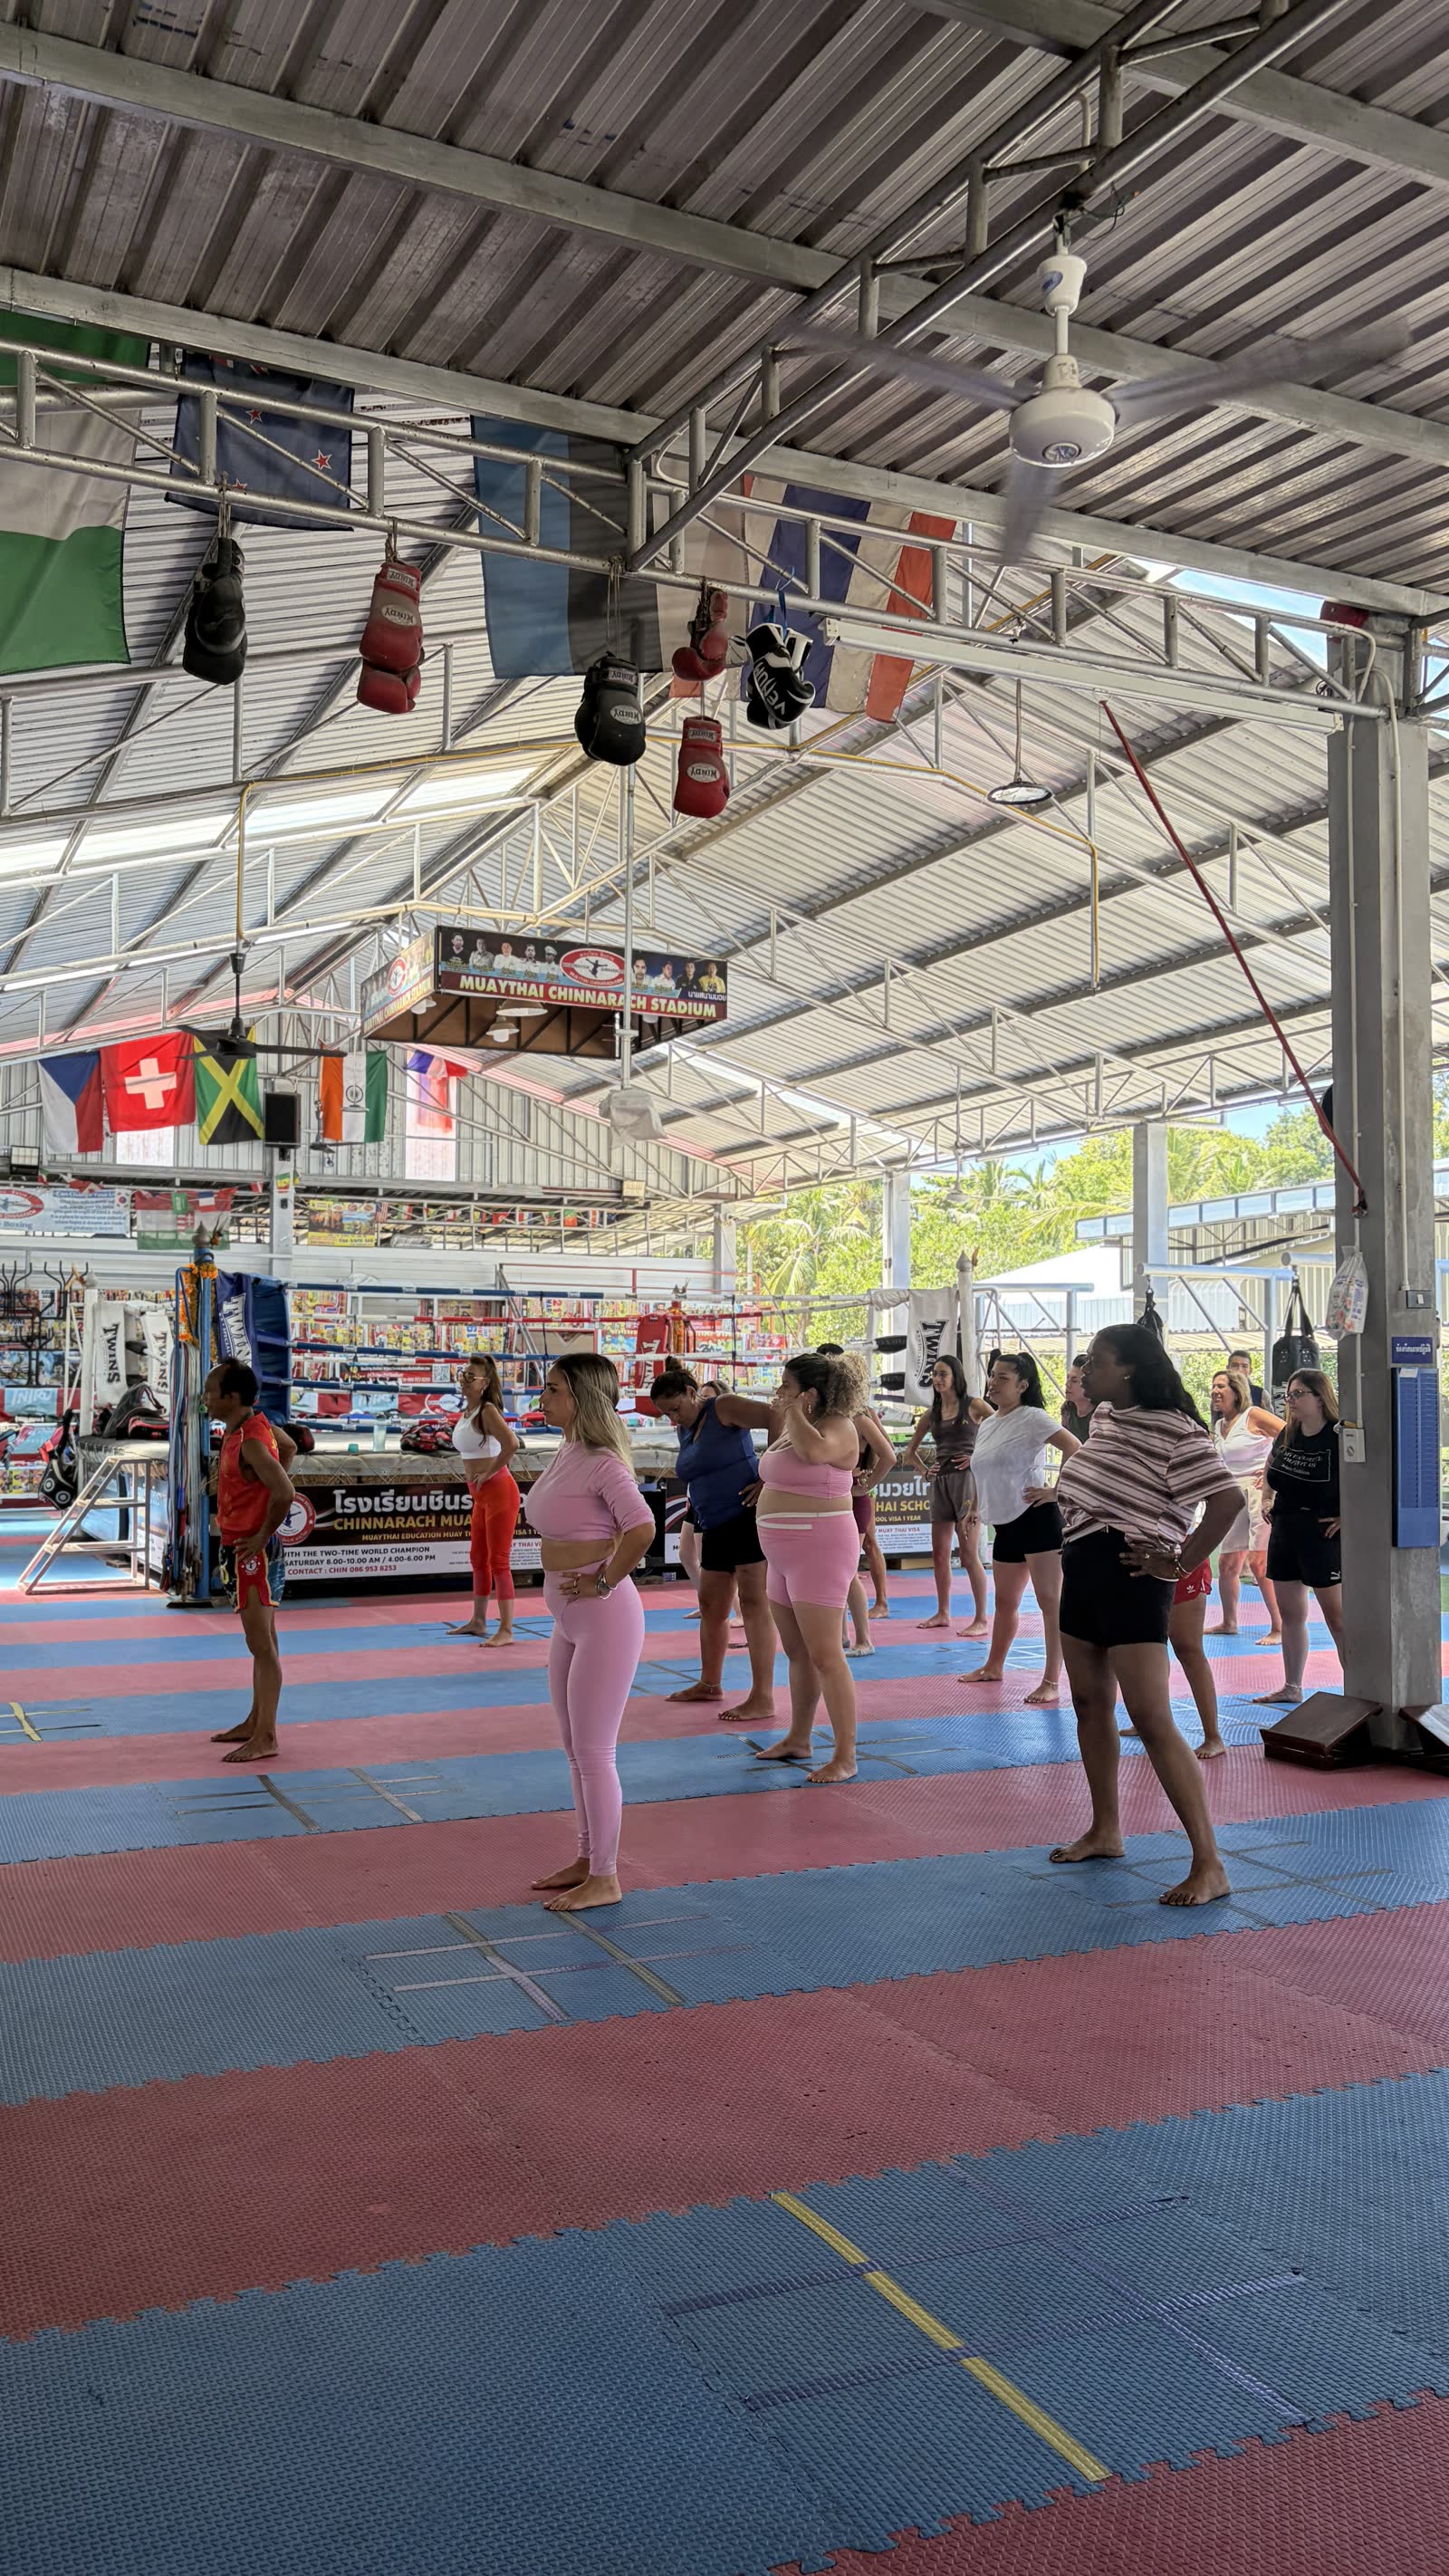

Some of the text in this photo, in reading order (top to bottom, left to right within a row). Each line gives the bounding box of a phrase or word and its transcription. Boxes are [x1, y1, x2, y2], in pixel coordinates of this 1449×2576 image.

[384, 607, 415, 624] WINDY
[753, 661, 786, 715] VENUM
[613, 708, 639, 721] WINDY
[689, 767, 717, 779] WINDY
[459, 975, 716, 1018] MUAYTHAI CHINNARACH STADIUM
[4, 1221, 33, 1230] Boxing
[102, 1322, 120, 1384] TWINS
[876, 1499, 930, 1512] HAI SCHO
[333, 1514, 472, 1531] CHINNARACH MUA
[362, 1533, 400, 1542] MUAYTHAI
[401, 1532, 442, 1540] EDUCATION
[320, 1549, 360, 1557] TWO-TIME
[326, 1557, 367, 1565] 8.00-10.00
[288, 1567, 322, 1575] CONTACT
